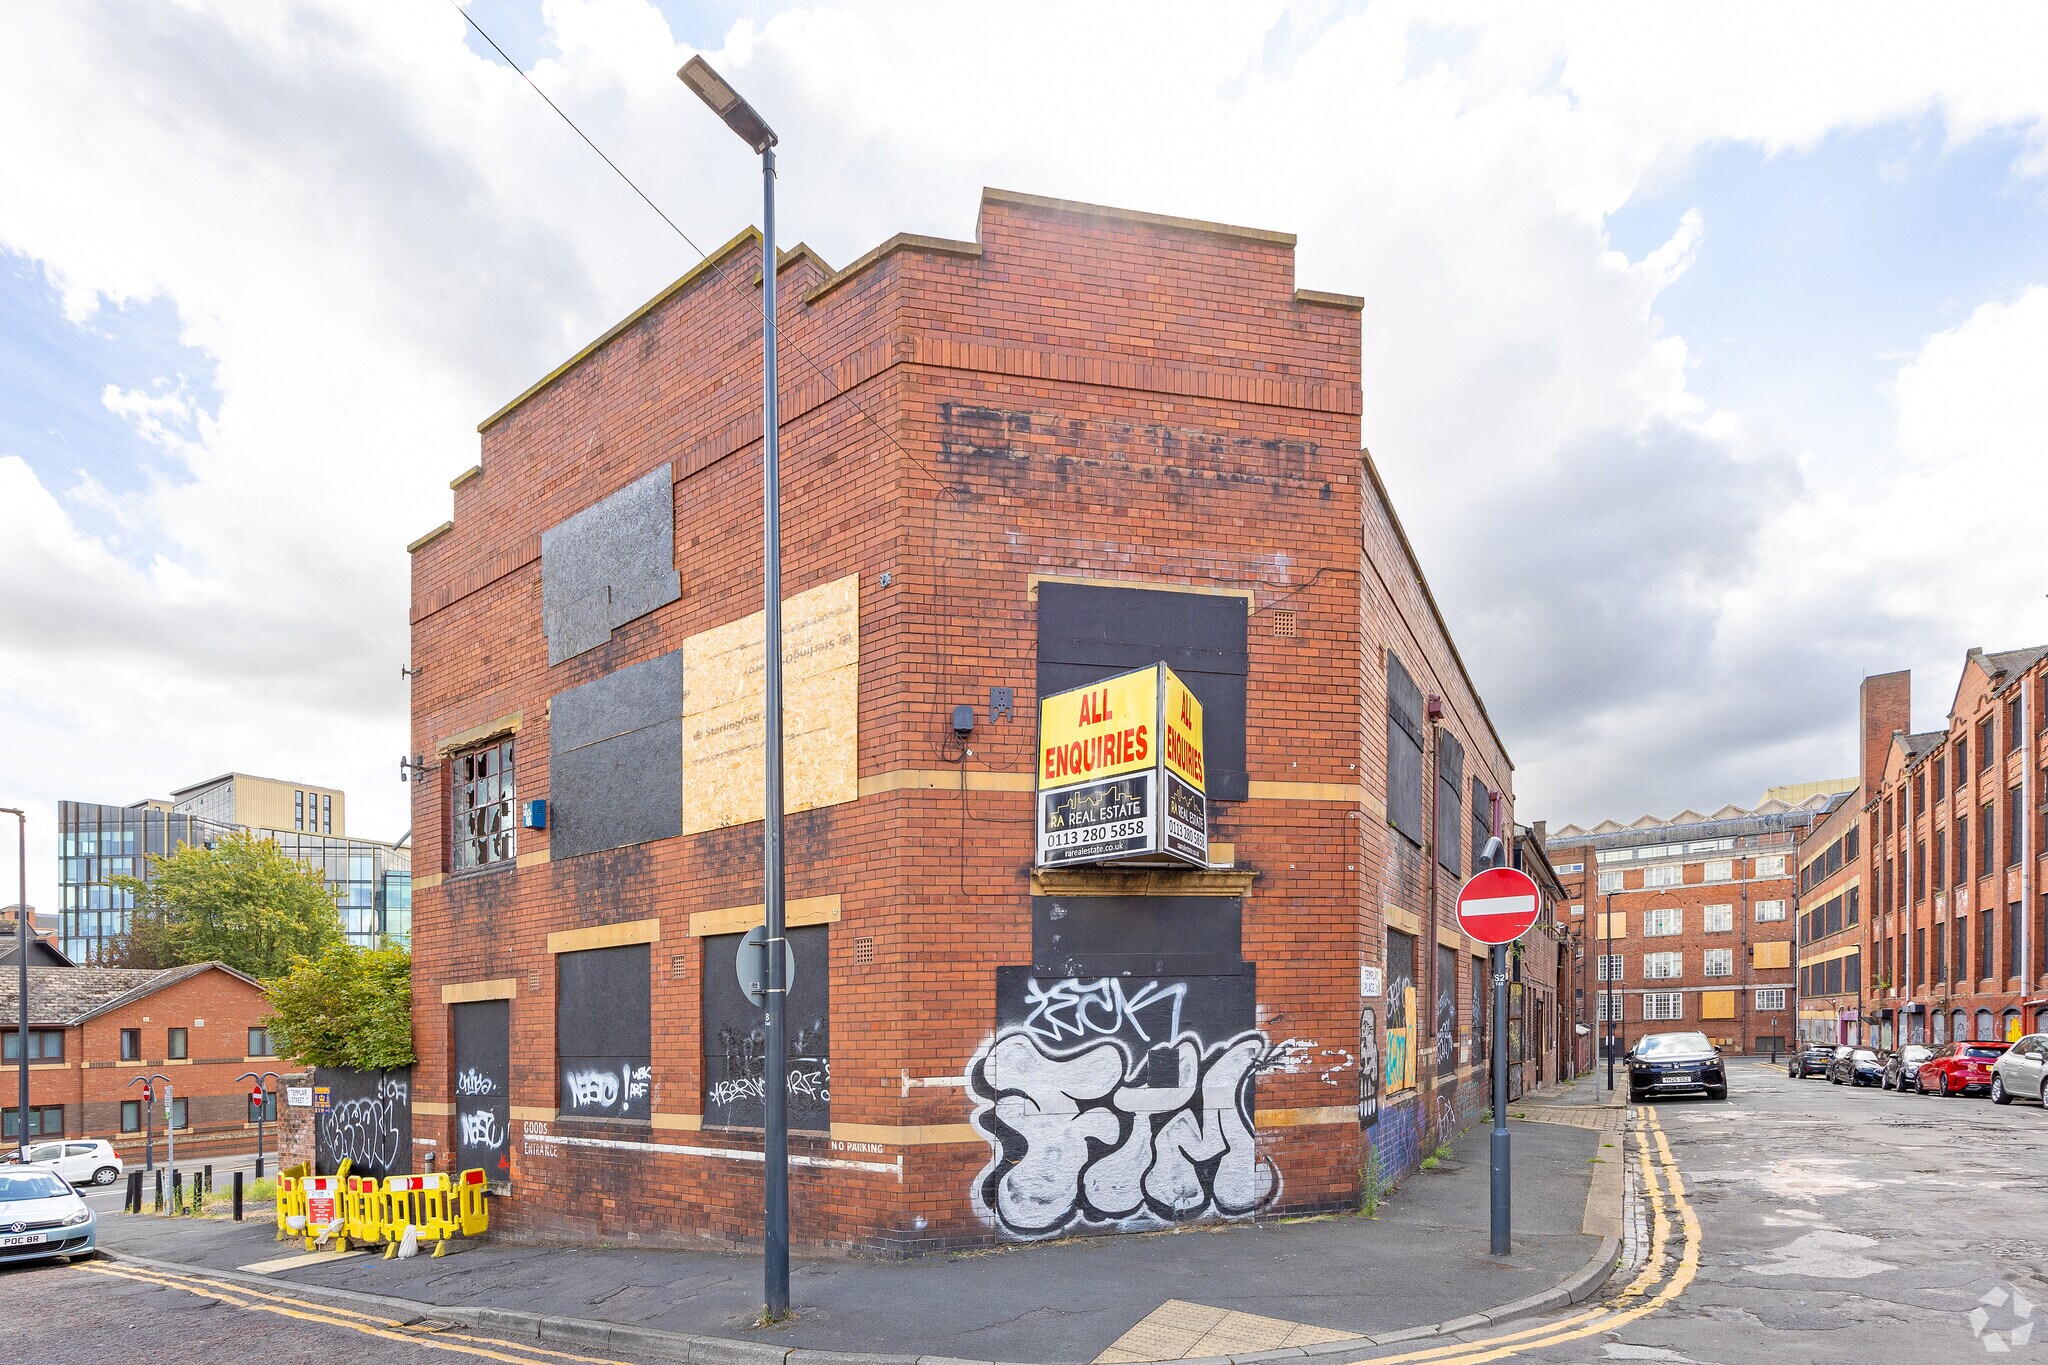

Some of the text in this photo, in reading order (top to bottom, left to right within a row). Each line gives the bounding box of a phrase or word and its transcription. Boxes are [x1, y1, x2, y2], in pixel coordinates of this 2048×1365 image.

[1079, 688, 1112, 727] ALL
[1181, 690, 1192, 730] ALL
[1045, 725, 1147, 779] ENQUIRIES
[1167, 724, 1203, 783] ENQUIRIES
[1050, 815, 1065, 828] RA
[1069, 810, 1096, 826] REAL
[1100, 801, 1140, 820] ESTATE
[1170, 800, 1204, 830] RA REAL ESTATE
[1047, 820, 1144, 848] 0113 280 5858
[1169, 820, 1205, 849] 0113 280 5858
[1064, 841, 1124, 858] rarealestate.co.uk
[1494, 973, 1505, 982] S2
[523, 1121, 548, 1135] GOODS
[524, 1142, 558, 1158] ENTRANCE
[831, 1140, 883, 1154] NO PARKING
[4, 1235, 40, 1245] POC 8R
